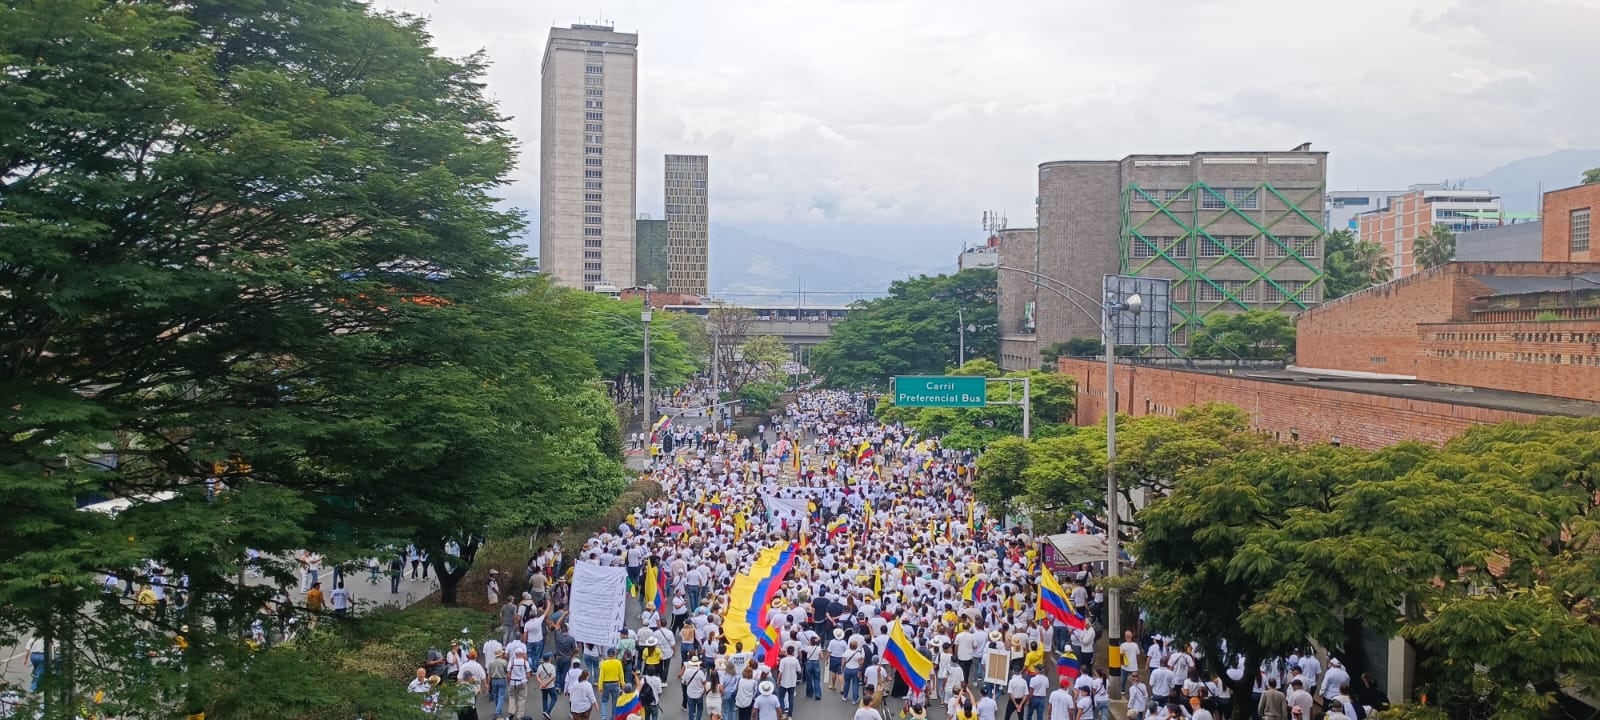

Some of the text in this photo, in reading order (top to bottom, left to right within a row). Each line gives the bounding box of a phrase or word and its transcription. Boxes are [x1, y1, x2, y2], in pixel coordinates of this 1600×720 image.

[926, 382, 954, 390] Carril
[899, 393, 981, 402] Preferencial Bus
